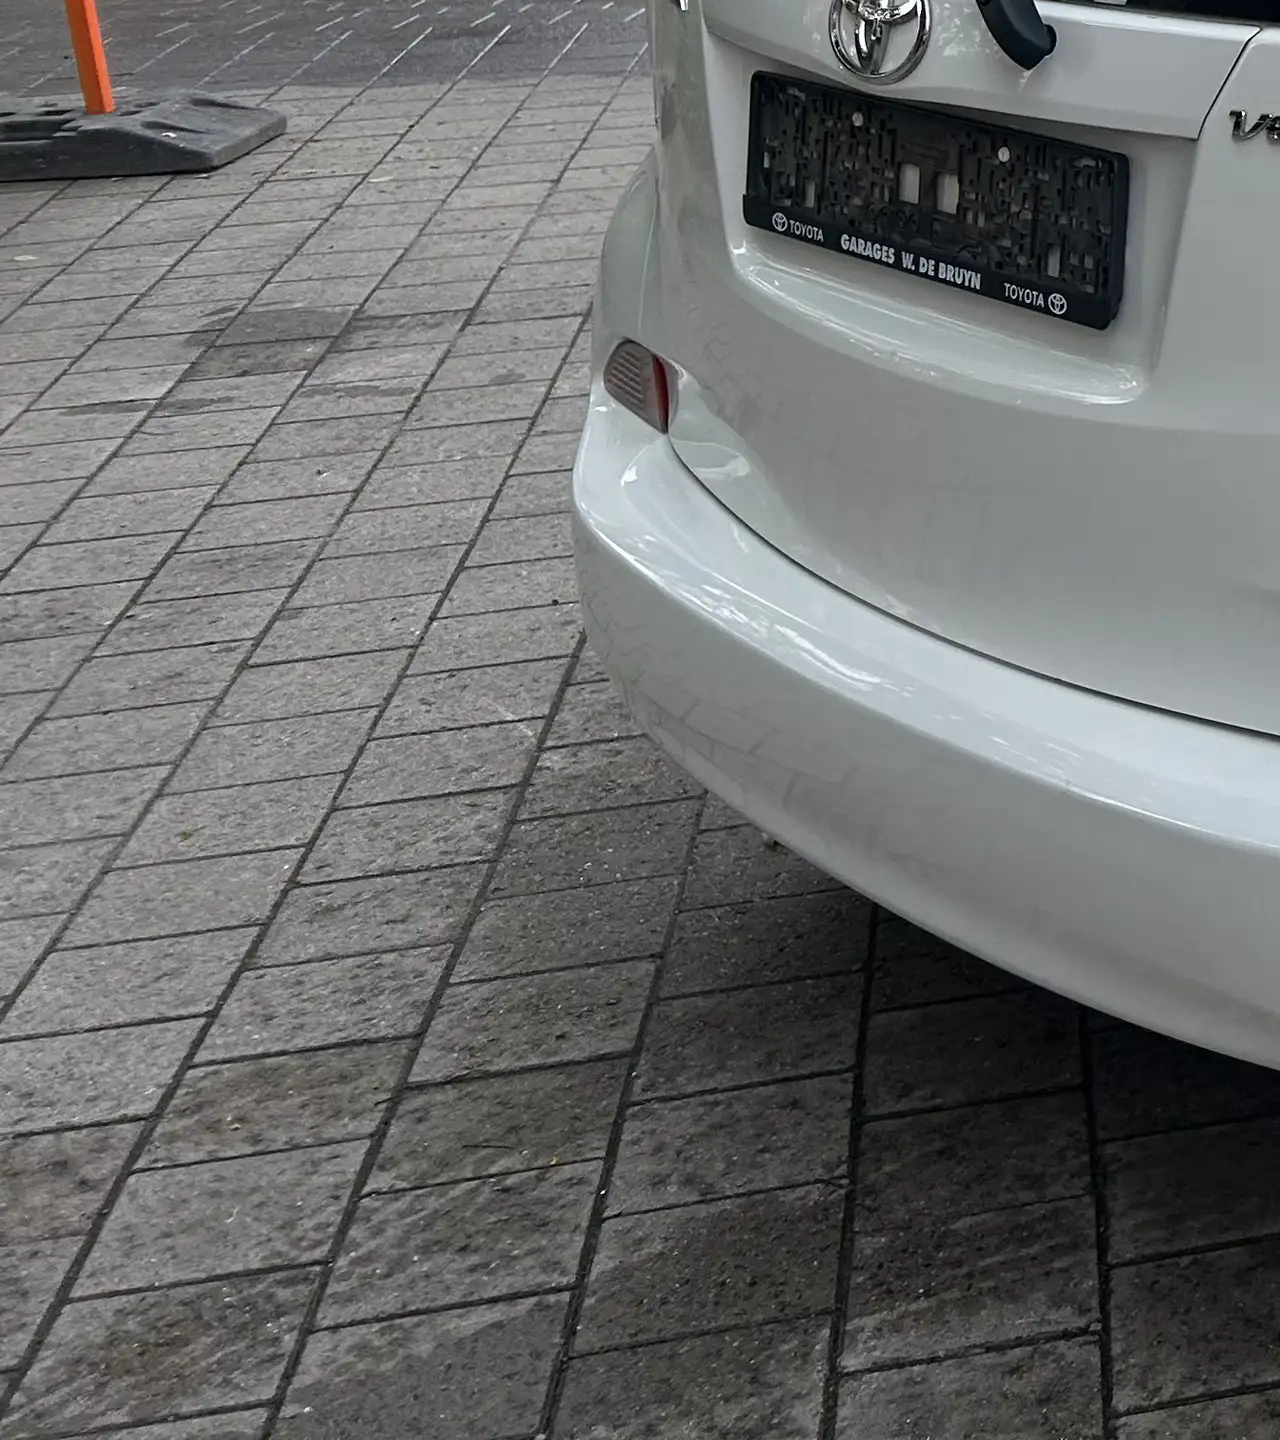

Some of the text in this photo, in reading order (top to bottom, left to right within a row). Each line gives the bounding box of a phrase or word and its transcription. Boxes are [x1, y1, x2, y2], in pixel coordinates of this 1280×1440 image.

[788, 219, 824, 243] TOYOTA
[840, 233, 982, 290] GARAGES W. DE BRUYN
[1003, 282, 1045, 310] TOYOTA
